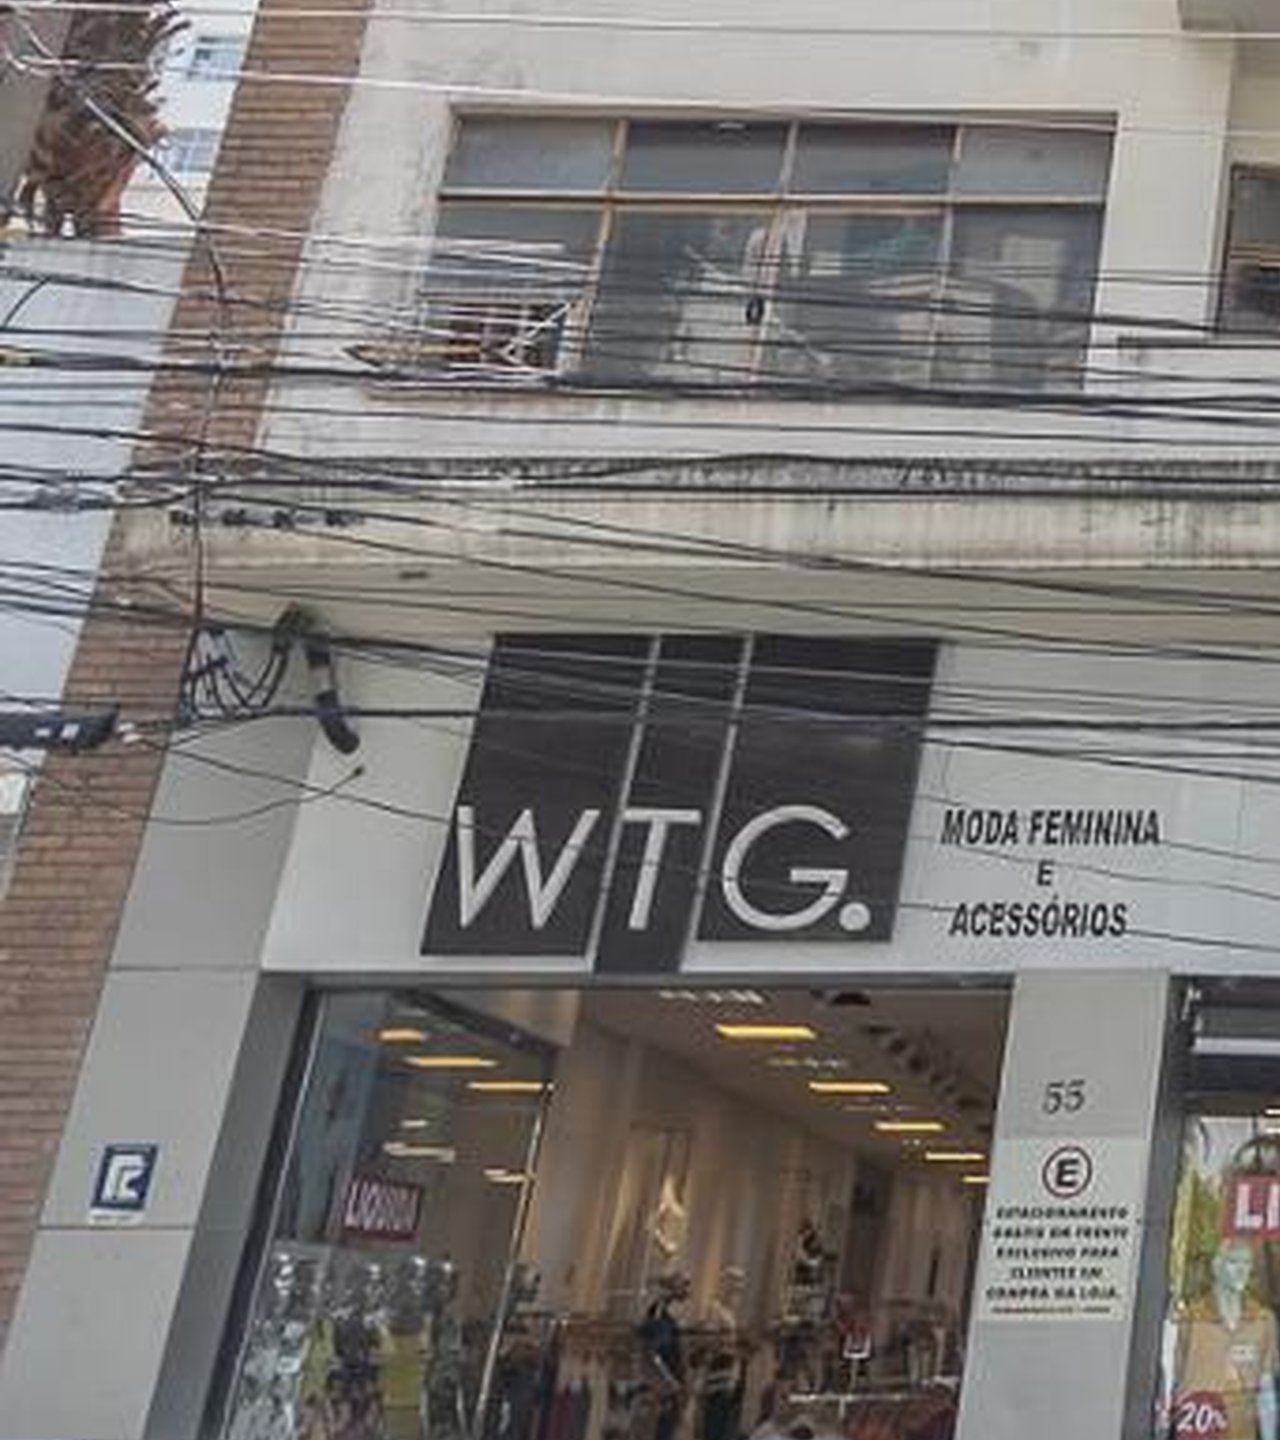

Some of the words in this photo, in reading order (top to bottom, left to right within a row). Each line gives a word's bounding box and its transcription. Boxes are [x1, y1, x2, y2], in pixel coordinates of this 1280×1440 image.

[940, 808, 1019, 846] MODA
[1026, 808, 1162, 847] FEMININA
[456, 804, 872, 931] WTG.
[1036, 859, 1055, 887] E
[948, 893, 1129, 938] ACESSÓRIOS
[1043, 1079, 1085, 1115] 55
[1054, 1157, 1081, 1188] E
